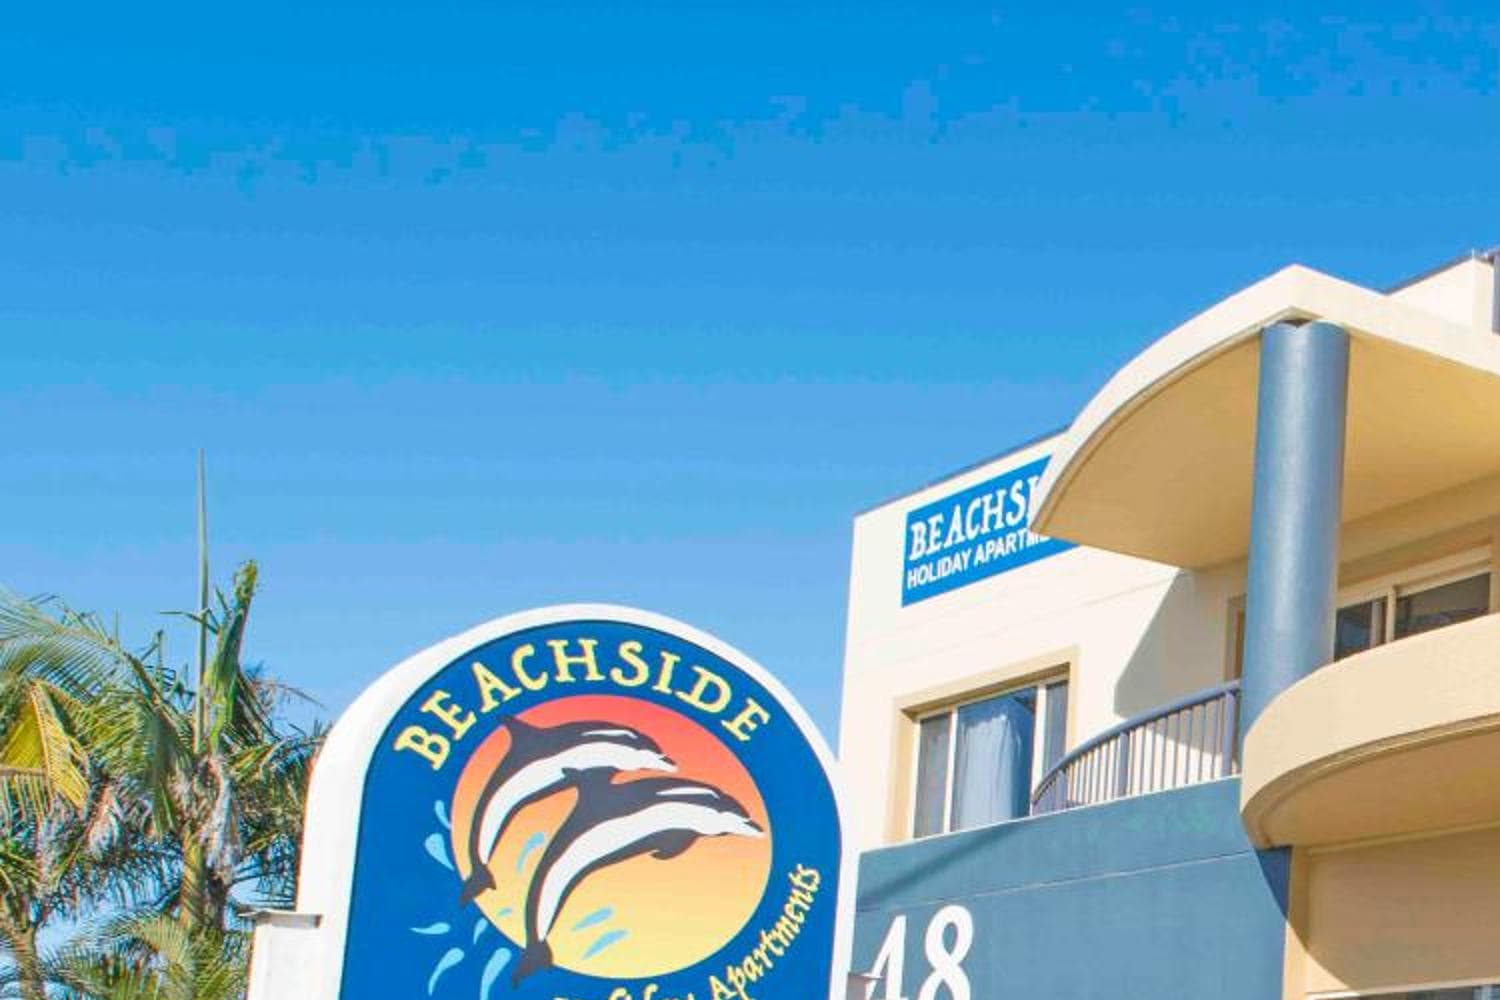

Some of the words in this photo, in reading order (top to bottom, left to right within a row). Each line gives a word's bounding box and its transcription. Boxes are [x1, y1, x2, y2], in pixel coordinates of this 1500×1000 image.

[909, 475, 1039, 560] BEACHSI
[907, 548, 972, 590] HOLIDAY
[394, 637, 771, 770] BEACHSIDE
